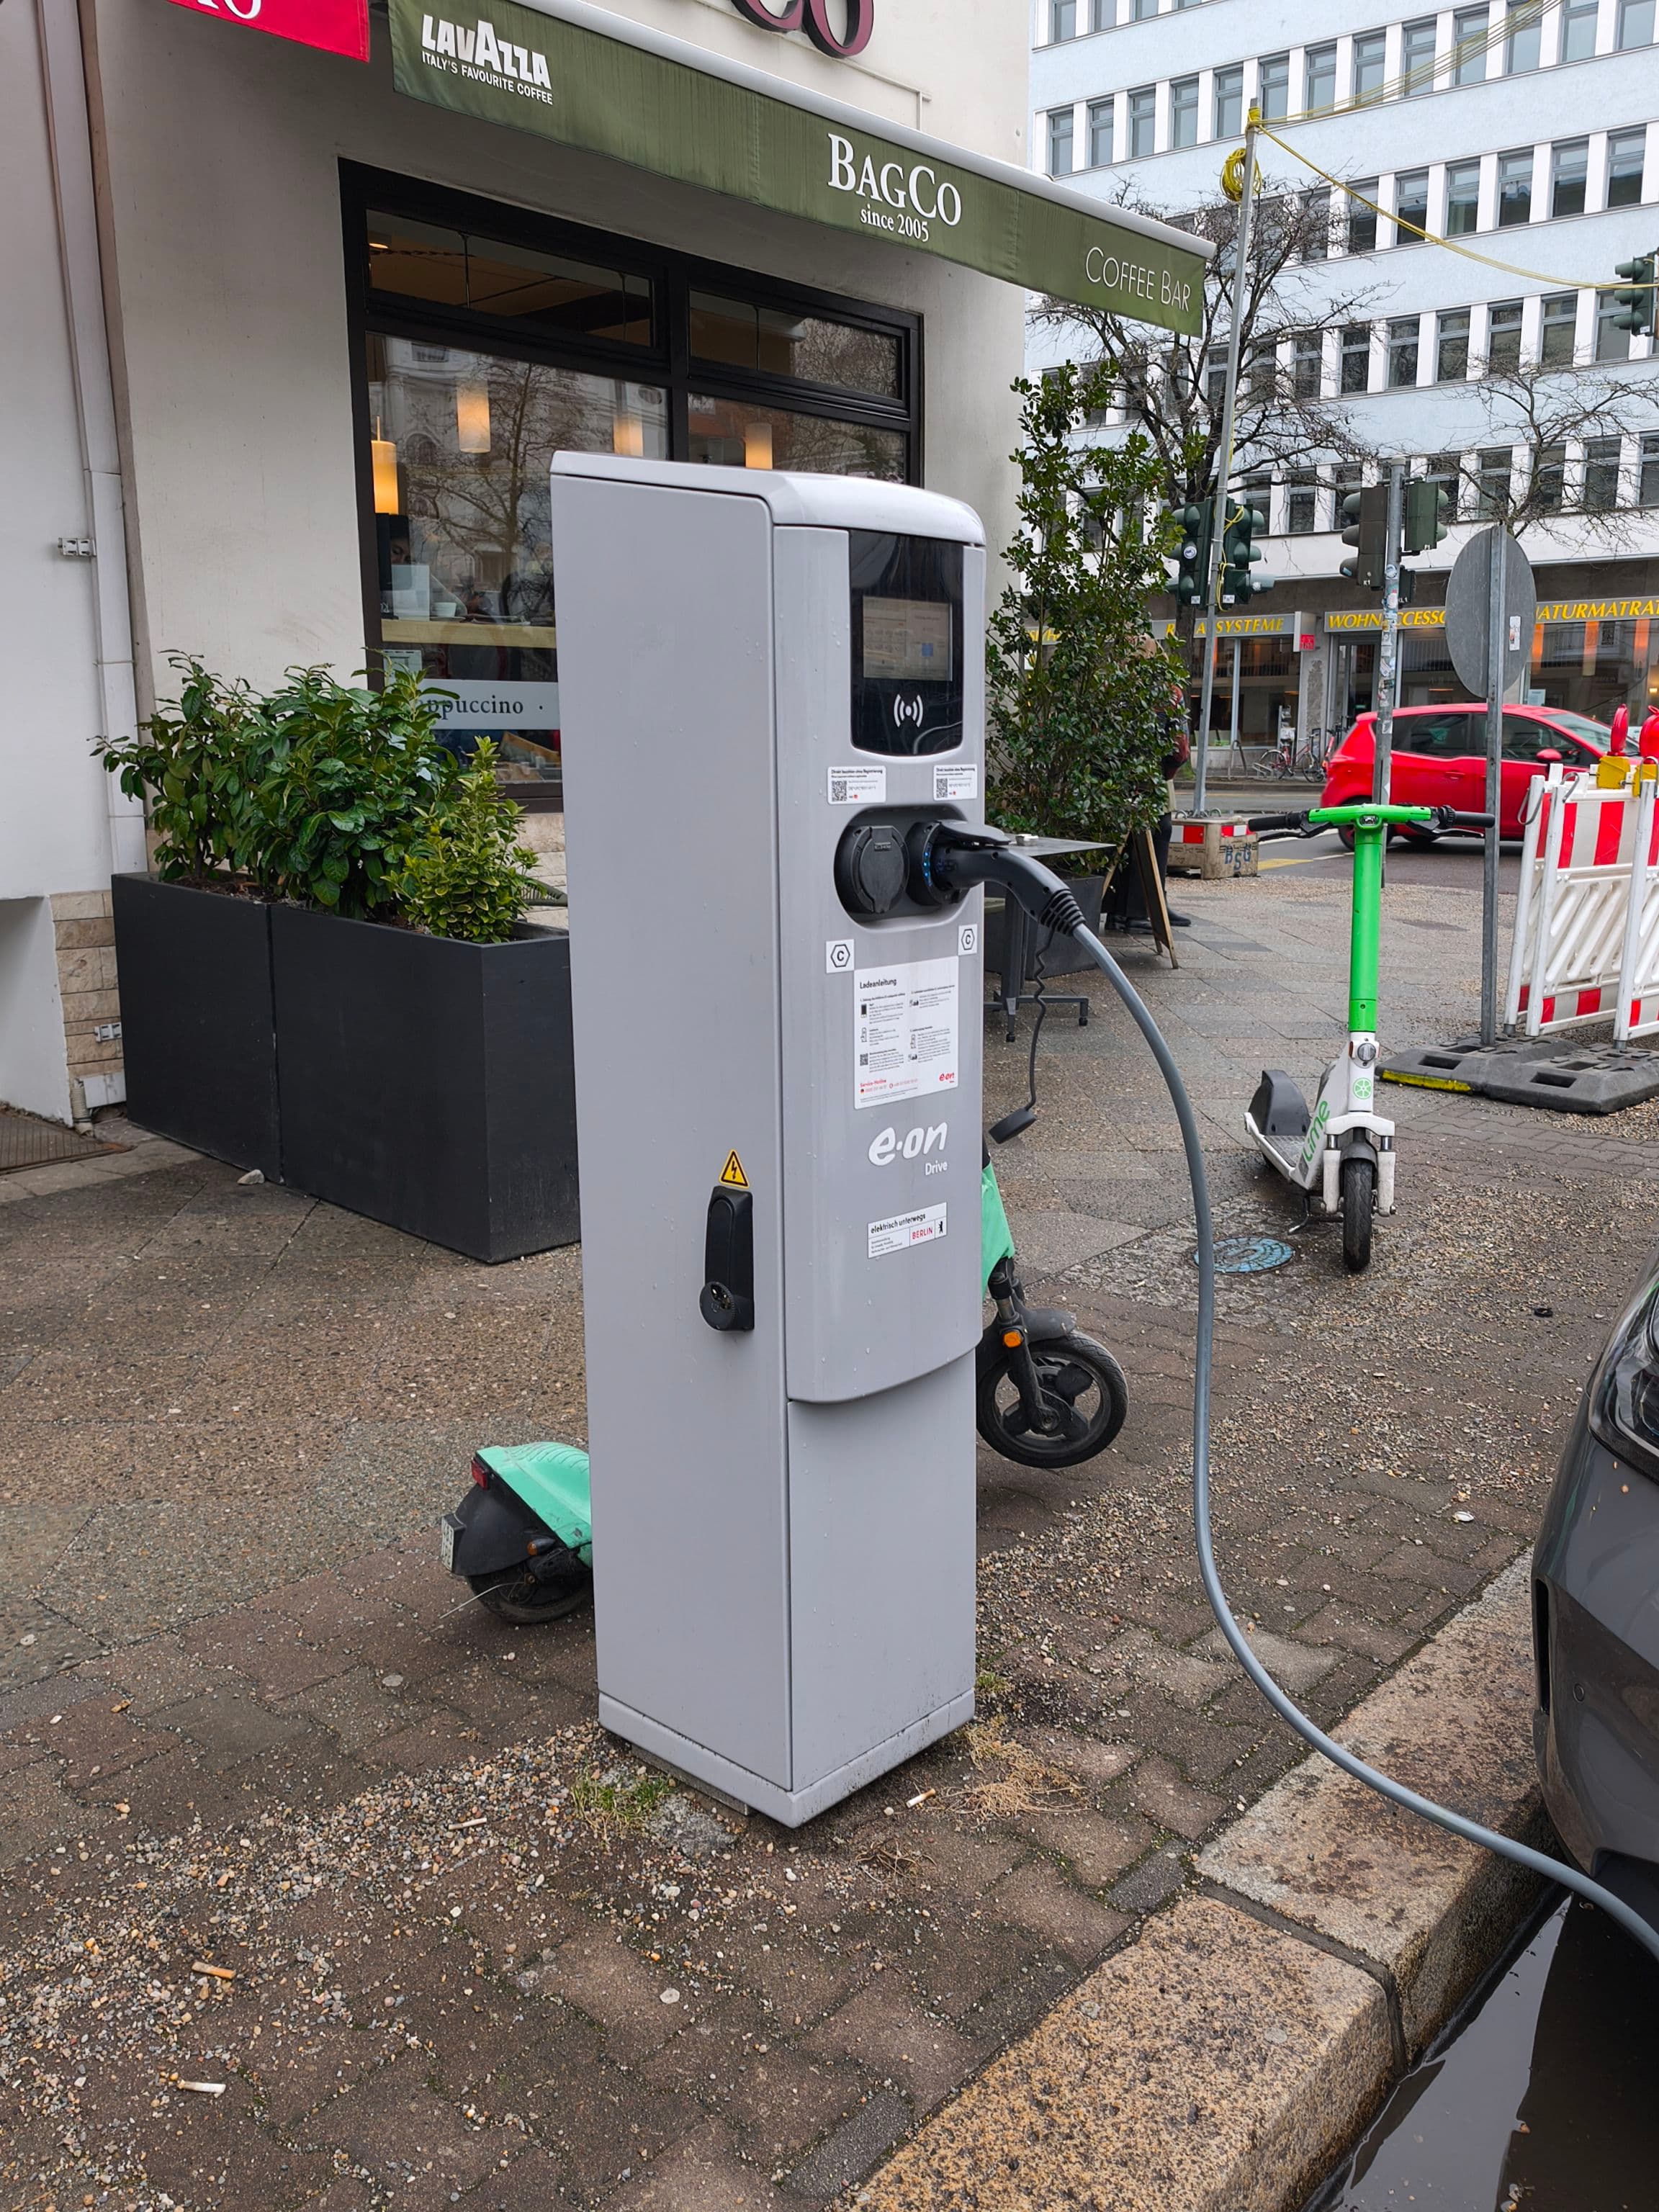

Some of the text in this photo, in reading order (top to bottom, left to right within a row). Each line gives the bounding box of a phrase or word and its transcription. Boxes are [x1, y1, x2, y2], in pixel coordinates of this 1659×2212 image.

[422, 14, 552, 90] LAVAZZA
[422, 51, 553, 105] ITALY'S FAVOURITE COFFEE
[860, 204, 929, 242] since 2005
[965, 935, 971, 945] C
[837, 950, 845, 961] C
[860, 979, 897, 989] Ladeanleitung
[1302, 1100, 1330, 1162] Lime
[925, 1160, 948, 1176] Drive
[871, 1213, 926, 1234] elektrisch unterwegs
[912, 1227, 933, 1239] BERLIN
